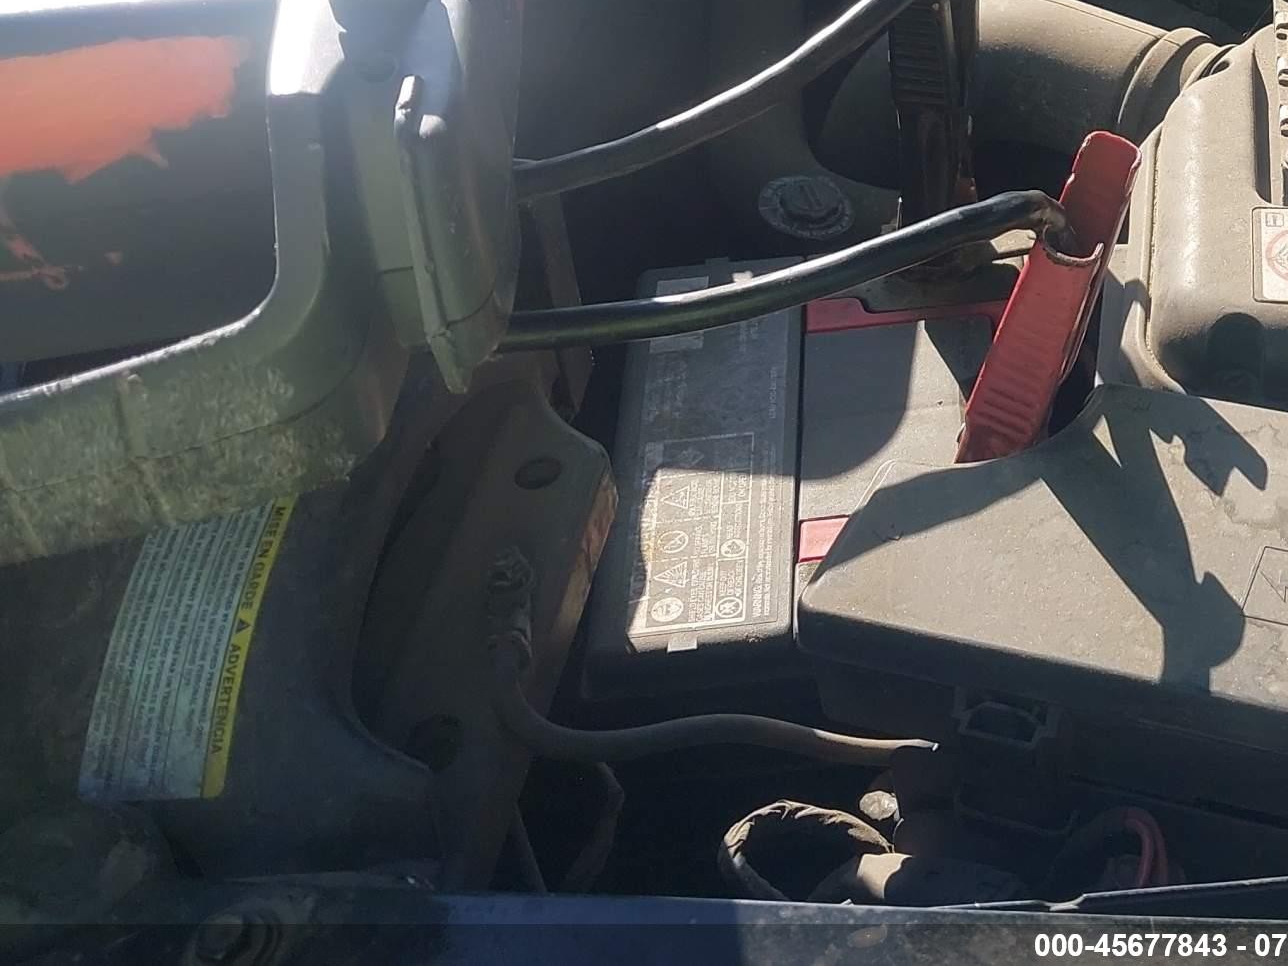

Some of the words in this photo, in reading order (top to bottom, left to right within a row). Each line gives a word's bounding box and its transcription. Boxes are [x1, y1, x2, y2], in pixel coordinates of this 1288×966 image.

[264, 506, 287, 538] MISE
[256, 537, 276, 559] EN
[241, 560, 266, 611] GARDE
[210, 643, 242, 755] ADVERTENCIA
